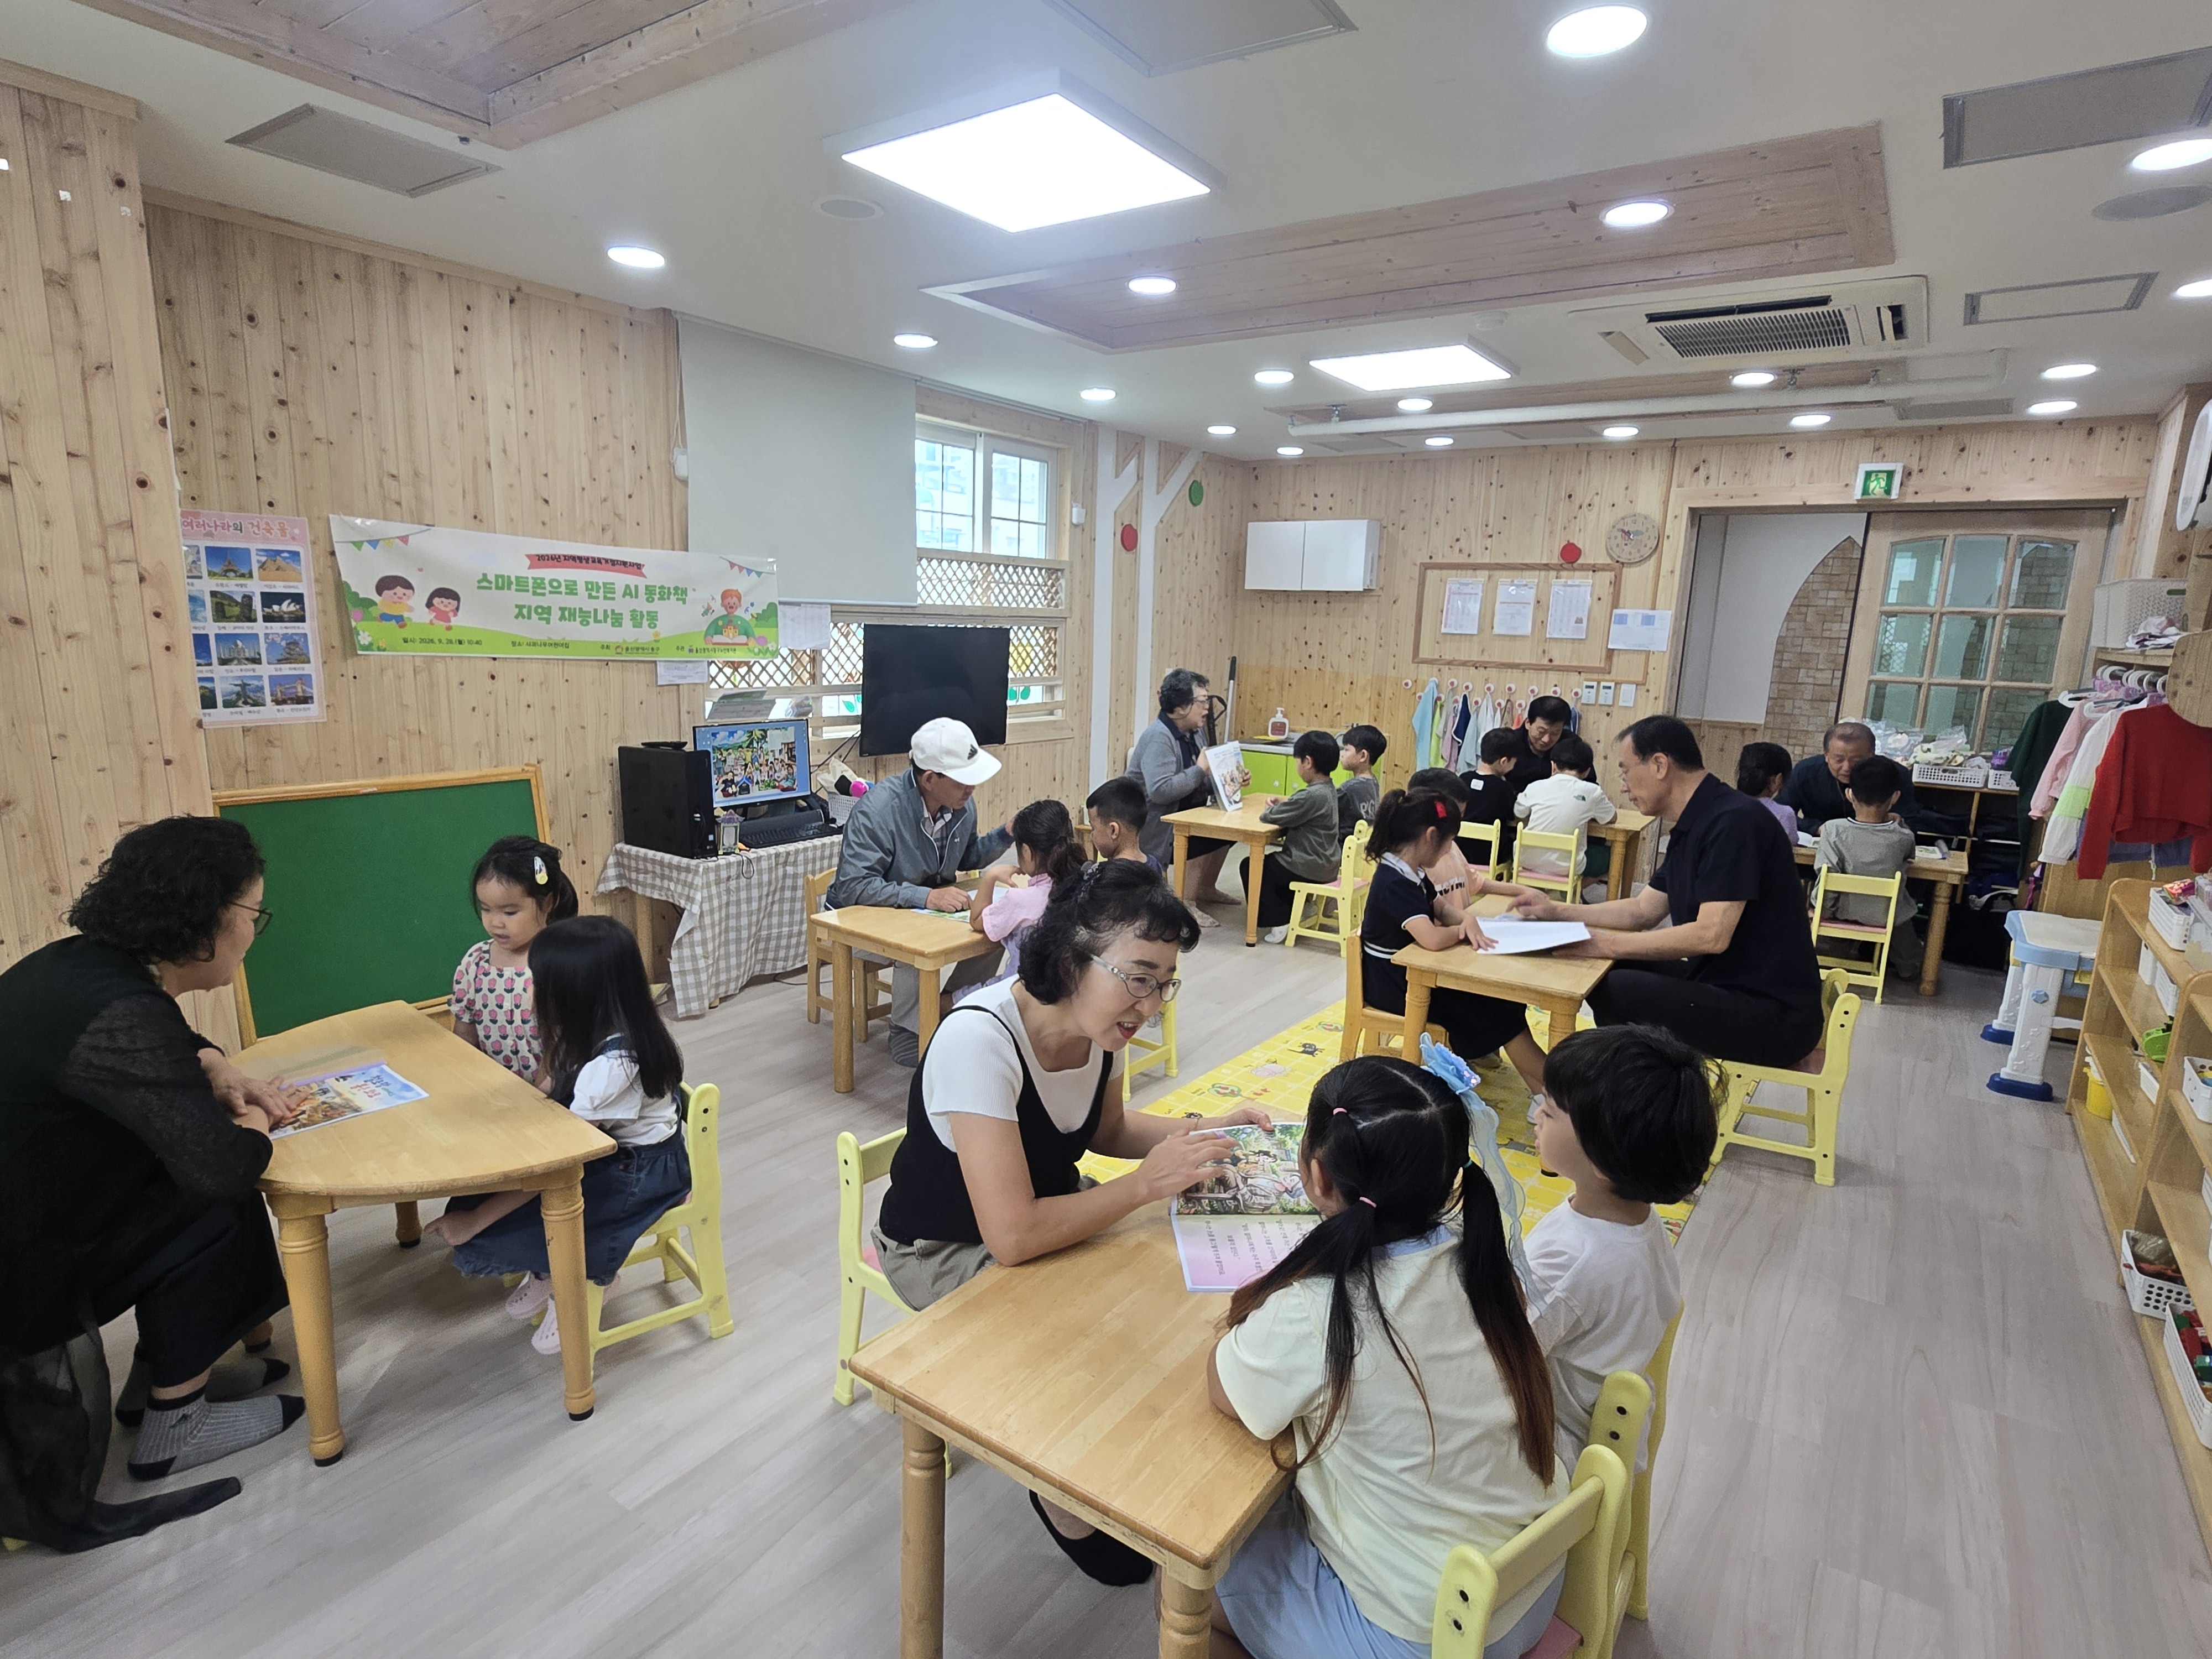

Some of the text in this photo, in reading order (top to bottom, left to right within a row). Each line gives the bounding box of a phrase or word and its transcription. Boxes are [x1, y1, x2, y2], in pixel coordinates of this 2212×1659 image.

[182, 519, 289, 538] 여러나라의 건축물
[476, 572, 688, 604] 스마트폰으로 만든 AI 동화책
[514, 603, 659, 629] 지역 재능나눔 활동
